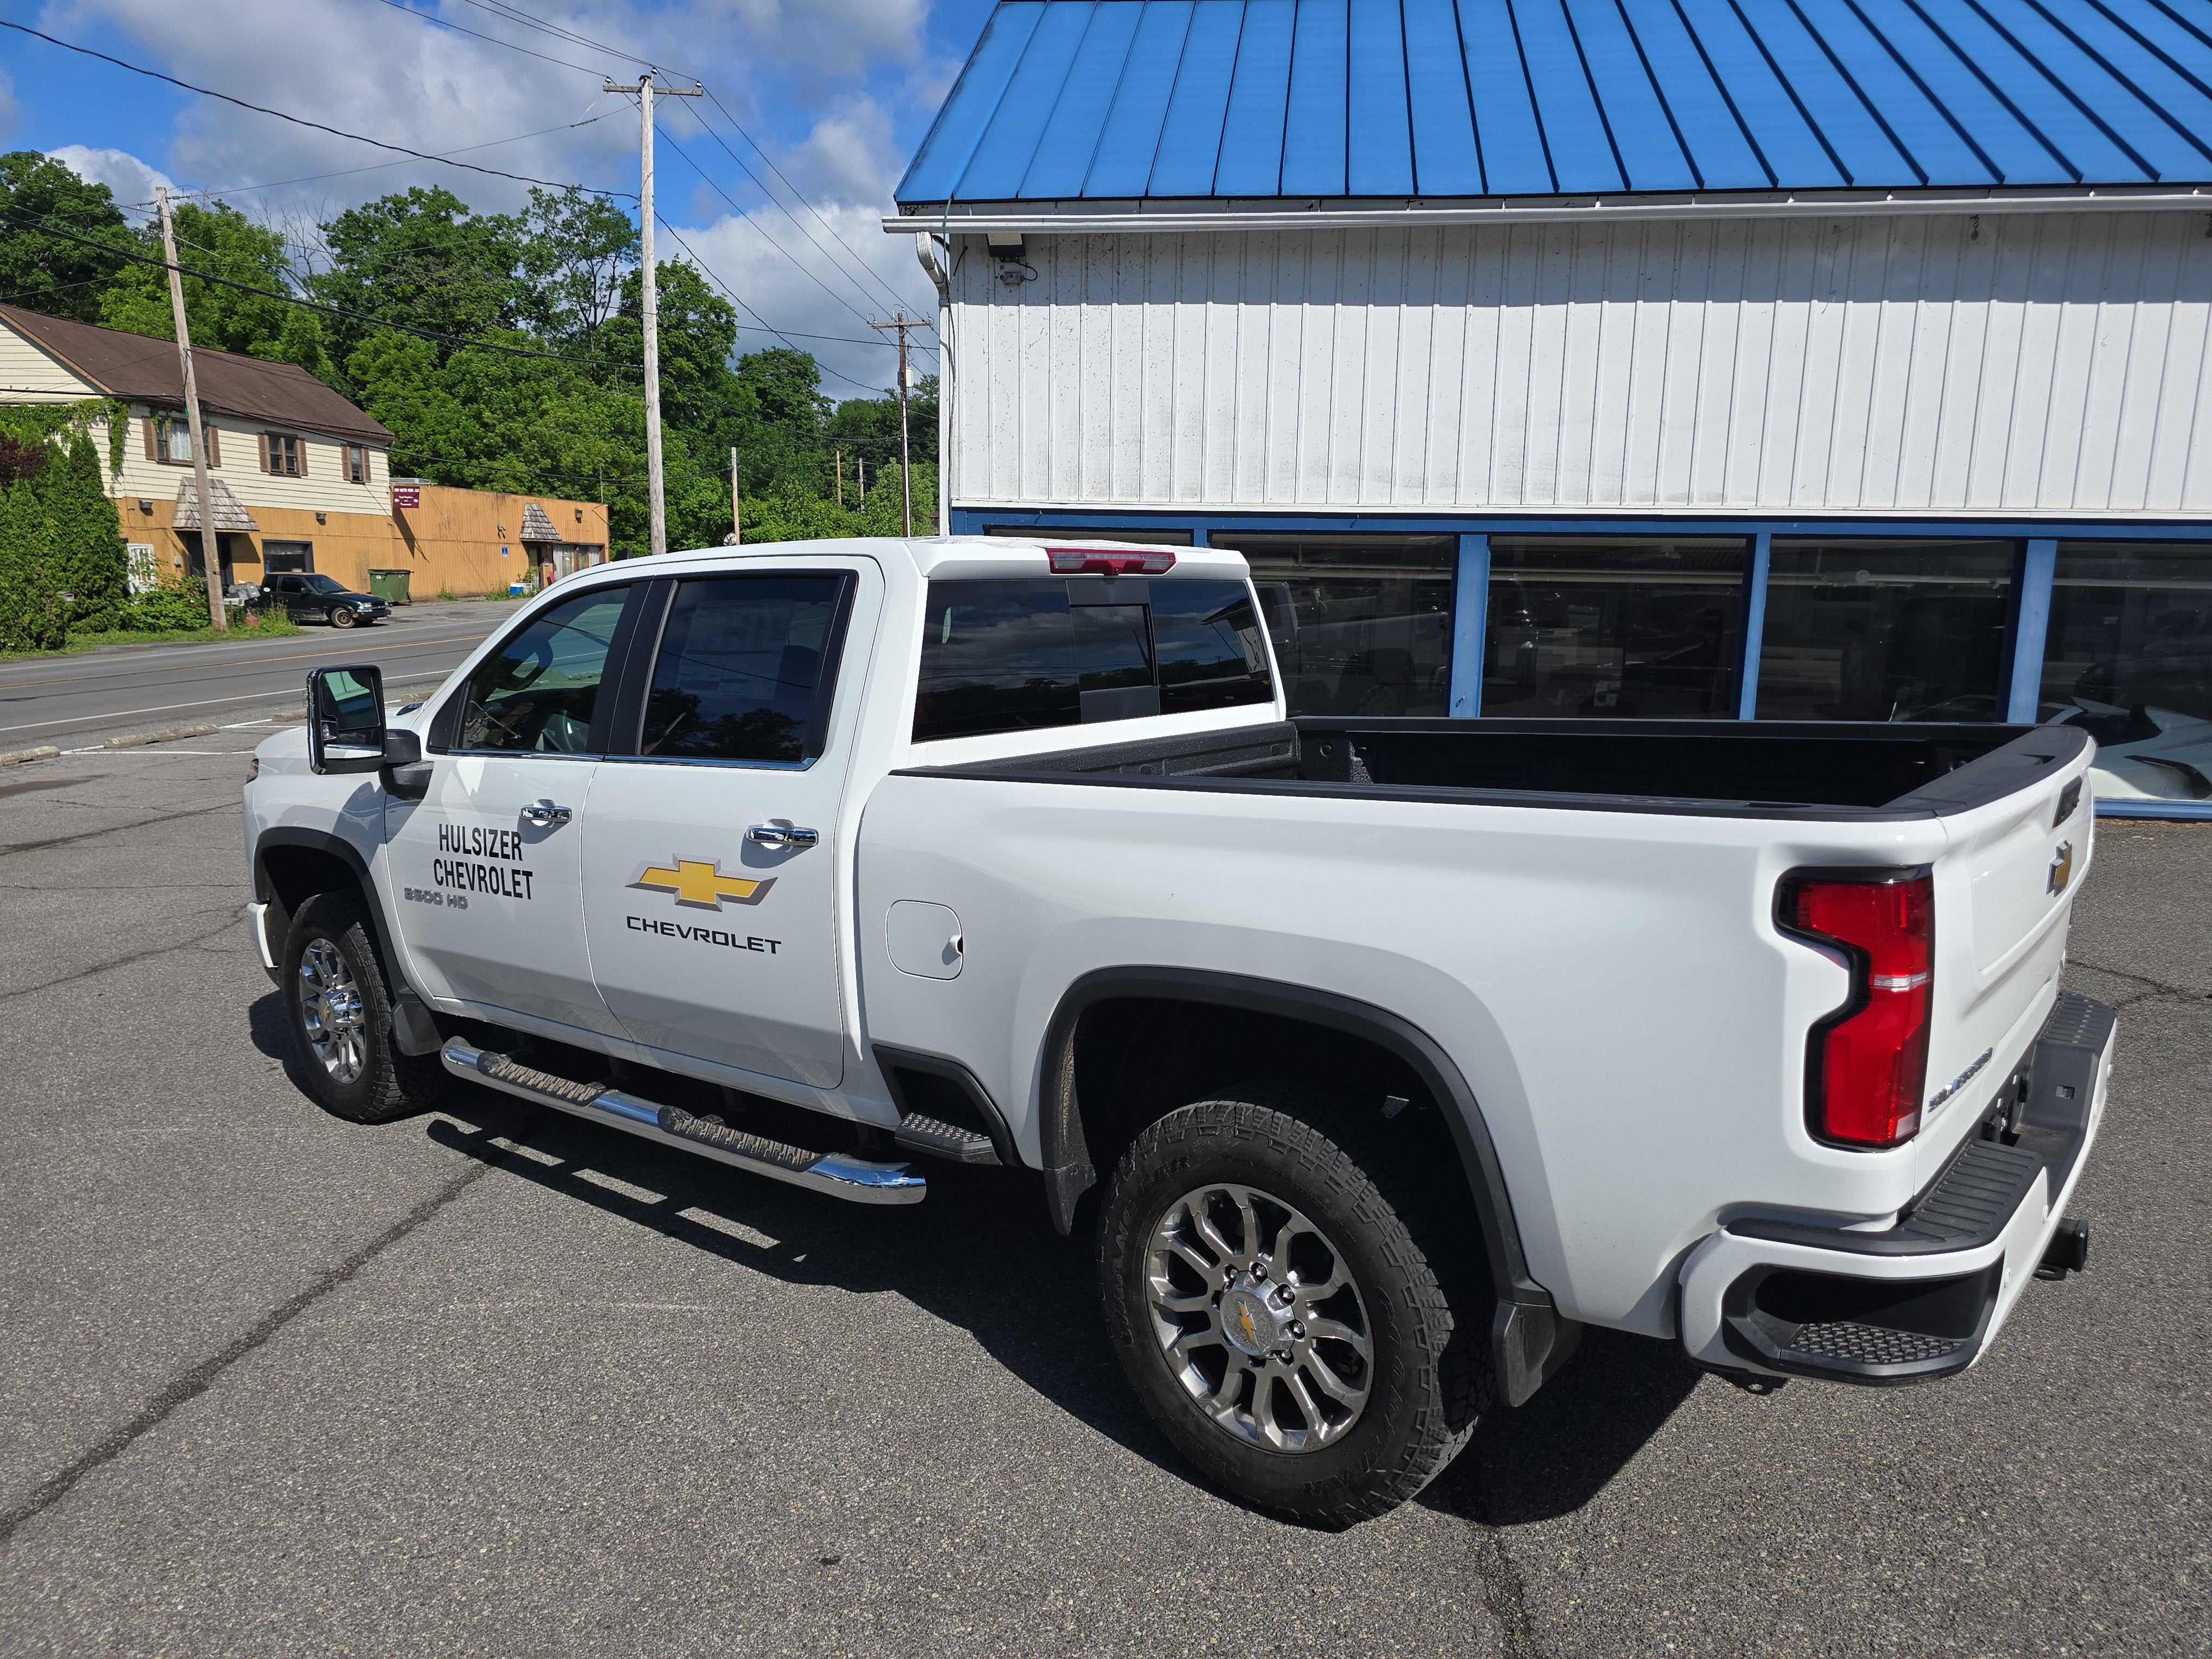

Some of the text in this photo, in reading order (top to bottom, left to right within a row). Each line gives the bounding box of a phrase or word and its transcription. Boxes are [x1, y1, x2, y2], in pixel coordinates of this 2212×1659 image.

[439, 824, 523, 861] HULSIZER
[433, 858, 533, 900] CHEVROLET
[446, 893, 469, 910] HD
[626, 916, 782, 954] CHEVROLET
